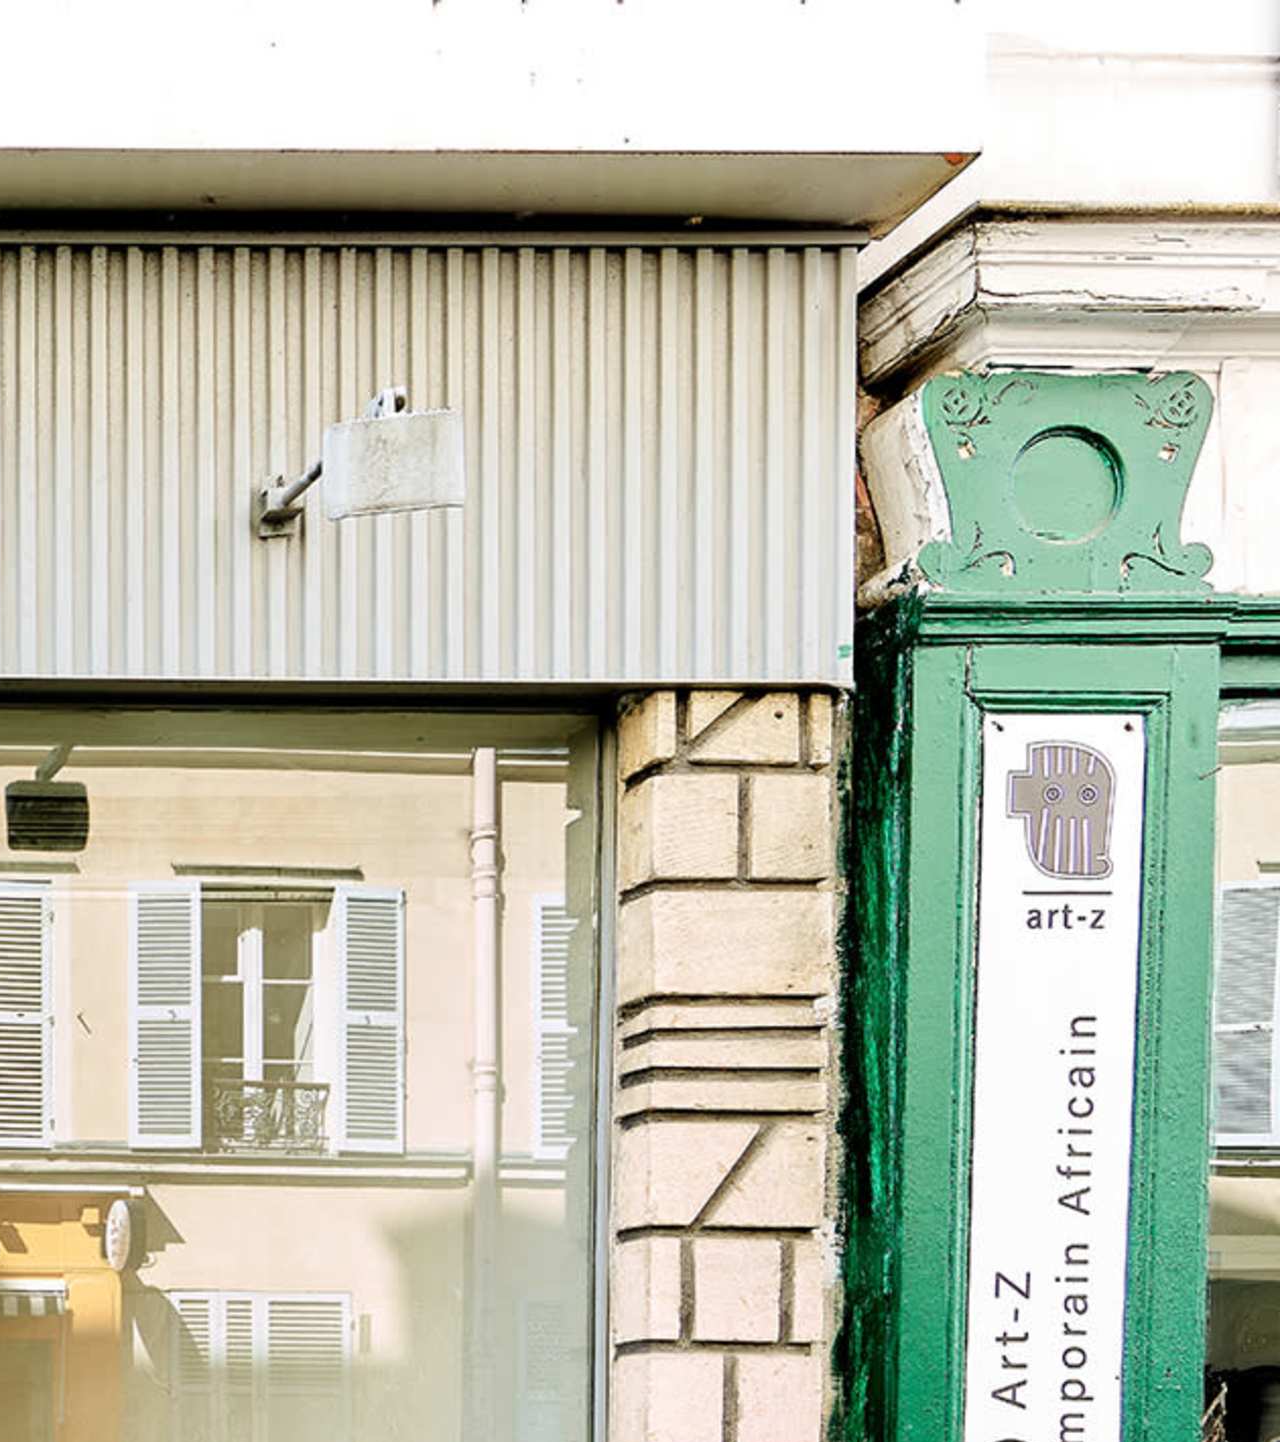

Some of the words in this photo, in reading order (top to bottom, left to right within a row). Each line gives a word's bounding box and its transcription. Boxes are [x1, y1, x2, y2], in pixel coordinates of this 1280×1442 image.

[1026, 903, 1106, 930] art-z
[1056, 1016, 1097, 1216] Africain
[991, 1271, 1031, 1410] Art-Z
